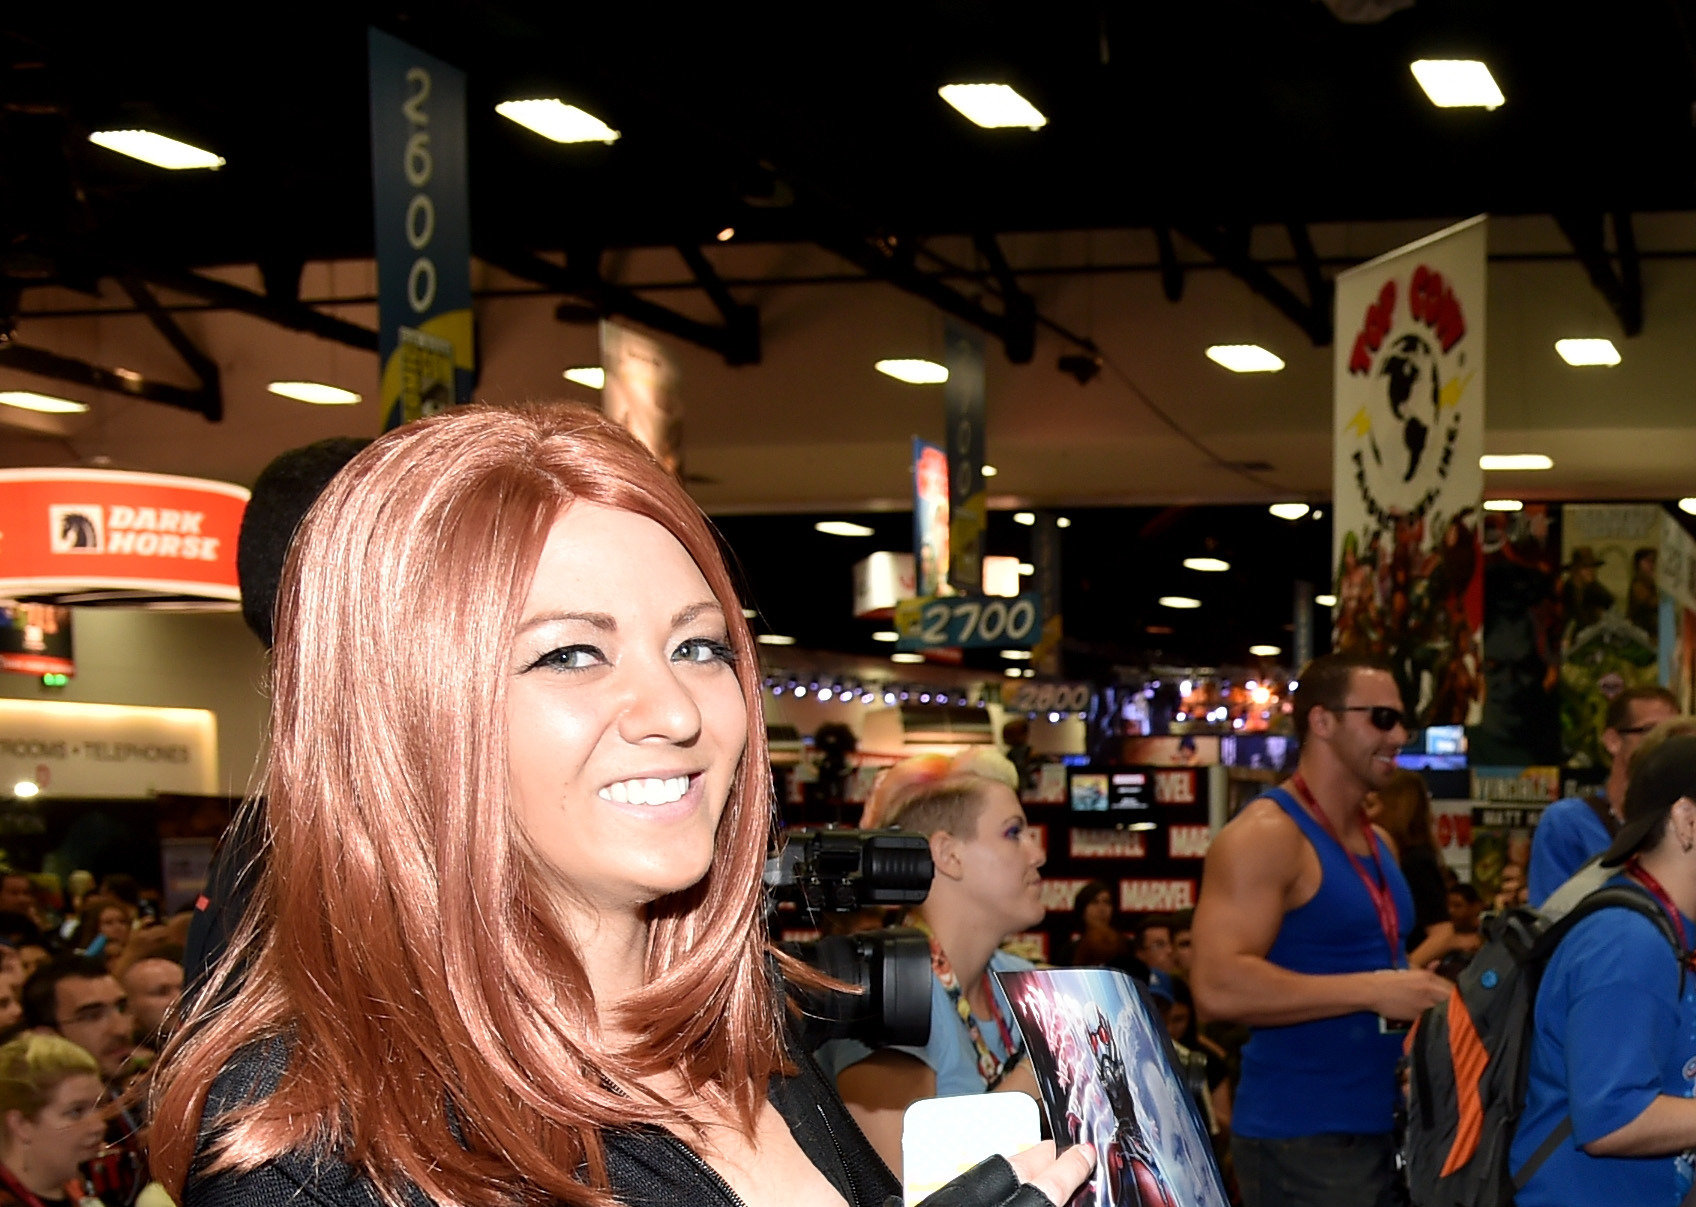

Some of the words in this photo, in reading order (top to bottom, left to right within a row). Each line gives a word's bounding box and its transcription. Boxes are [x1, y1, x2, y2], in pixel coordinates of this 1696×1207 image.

[402, 67, 437, 313] 2600
[107, 504, 204, 533] DARK
[106, 529, 220, 562] HORSE
[921, 601, 1036, 643] 2700
[1121, 881, 1194, 911] MARVEL
